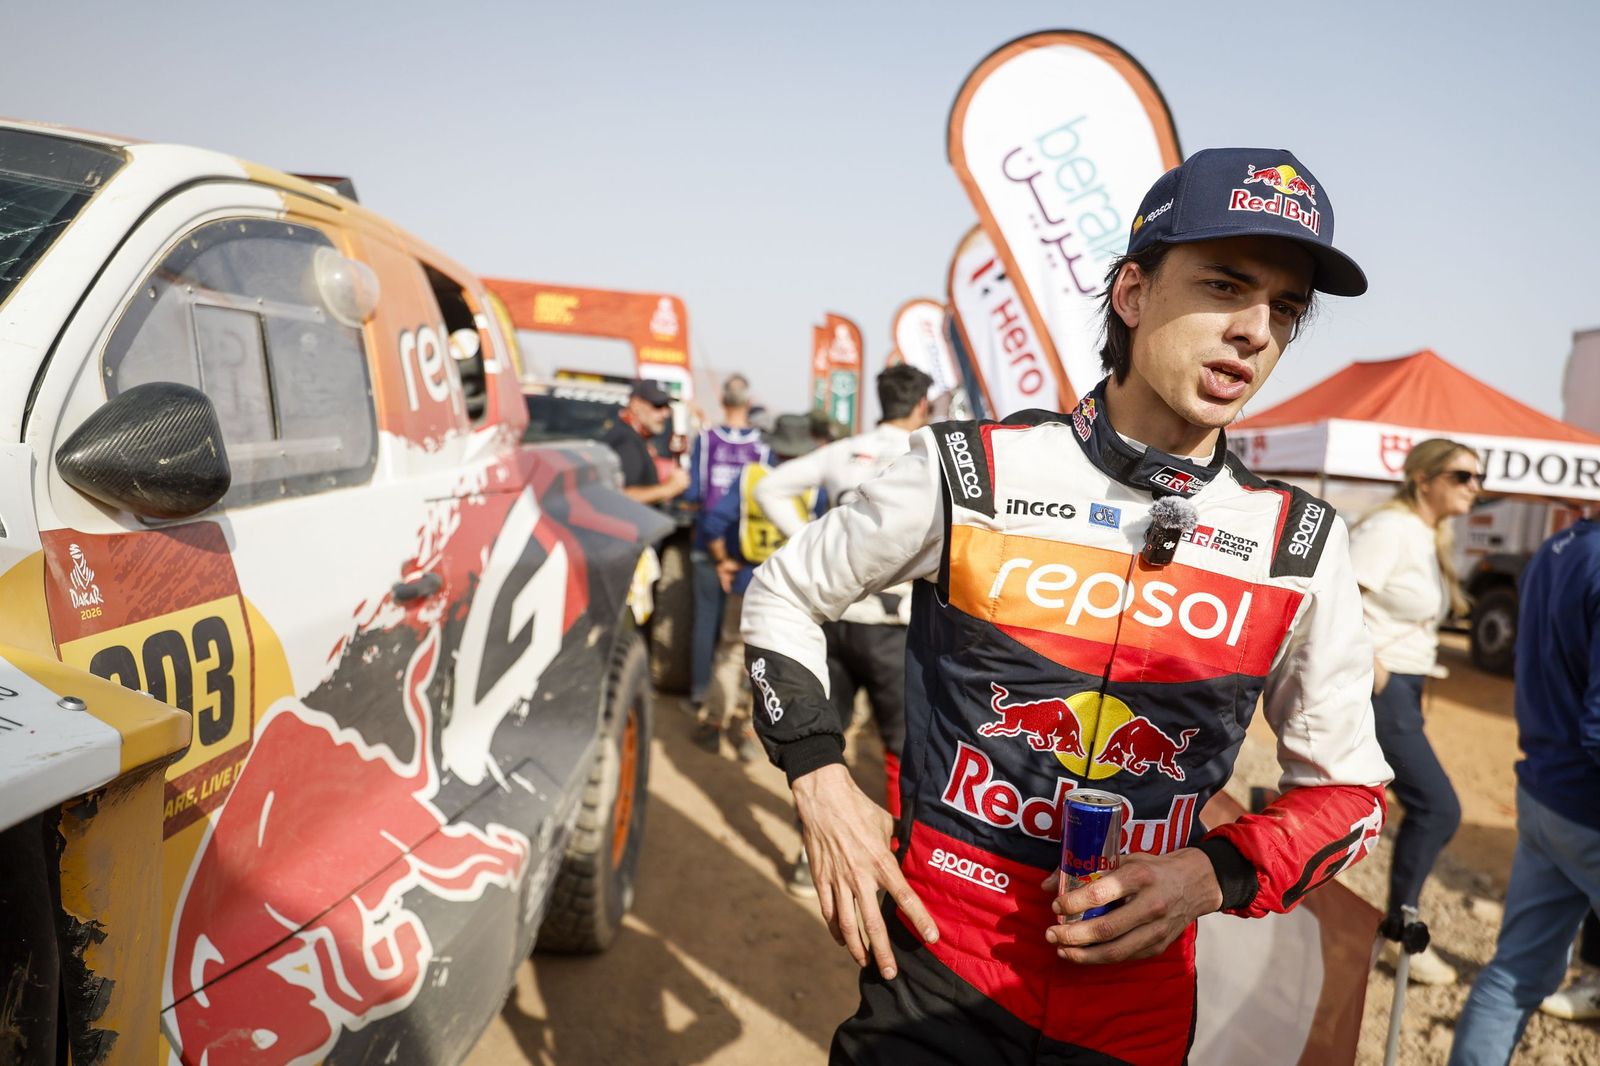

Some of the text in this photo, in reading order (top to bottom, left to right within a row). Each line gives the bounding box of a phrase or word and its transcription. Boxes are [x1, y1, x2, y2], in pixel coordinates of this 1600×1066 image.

[1228, 188, 1321, 236] Red Bull
[991, 298, 1044, 396] Hero
[945, 431, 982, 499] sparco
[1210, 543, 1250, 562] Racing
[1213, 536, 1253, 554] GAZOO
[1217, 529, 1259, 548] TOYOTA
[1288, 503, 1326, 559] sparco
[69, 584, 104, 608] DAKAR
[81, 607, 103, 620] 2026
[988, 558, 1253, 647] repsol
[751, 657, 784, 725] sparco
[201, 766, 233, 800] LIVE
[940, 740, 1078, 842] Red
[928, 847, 1010, 894] sparco
[1065, 850, 1095, 872] Red
